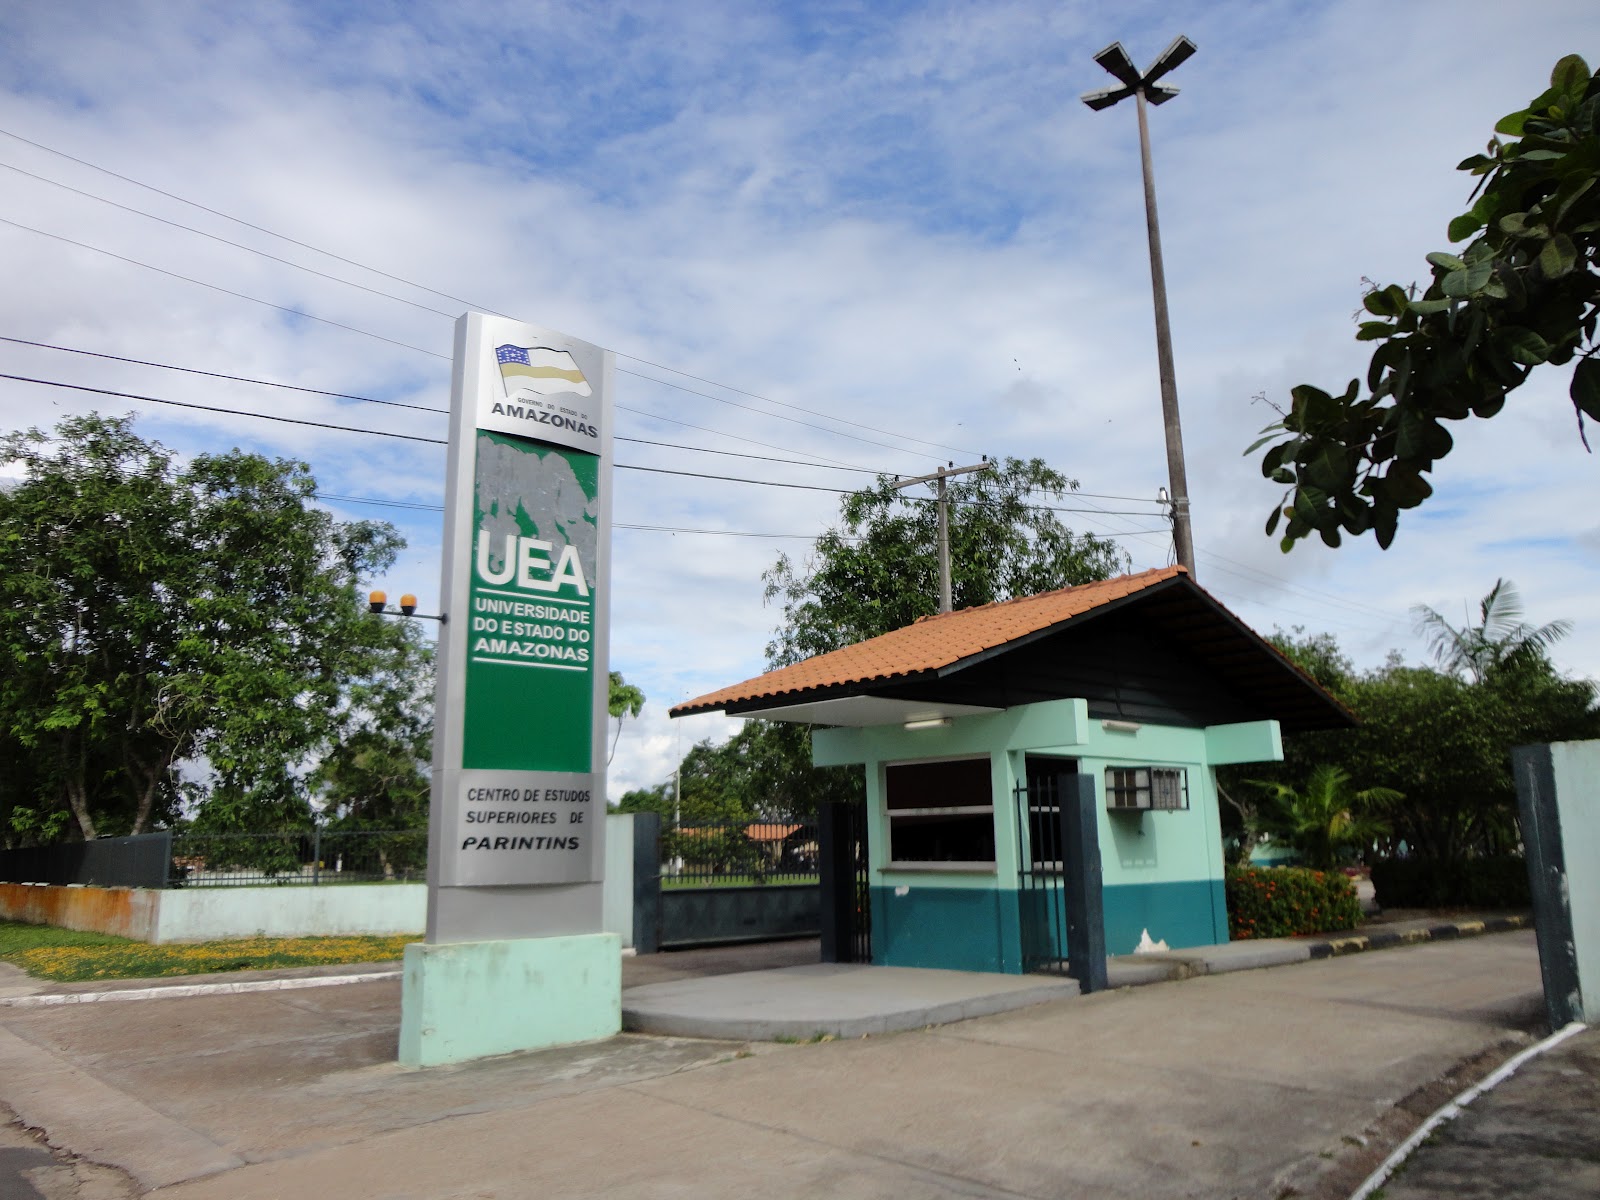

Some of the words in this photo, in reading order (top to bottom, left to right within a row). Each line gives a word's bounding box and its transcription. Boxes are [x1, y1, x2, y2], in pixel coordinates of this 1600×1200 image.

[517, 397, 543, 408] GOVERNO
[560, 406, 578, 416] ESTADO
[491, 402, 598, 438] AMAZONAS
[477, 529, 590, 596] UEA
[475, 597, 590, 624] UNIVERSIDADE
[473, 617, 498, 632] DO
[502, 621, 565, 640] ESTADO
[569, 628, 590, 643] DO
[474, 637, 590, 662] AMAZONAS
[467, 788, 520, 802] CENTRO
[523, 789, 540, 802] DE
[545, 789, 591, 802] ESTUDOS
[466, 811, 557, 824] SUPERIORES
[569, 811, 584, 824] DE
[462, 836, 580, 850] PARINTINS
